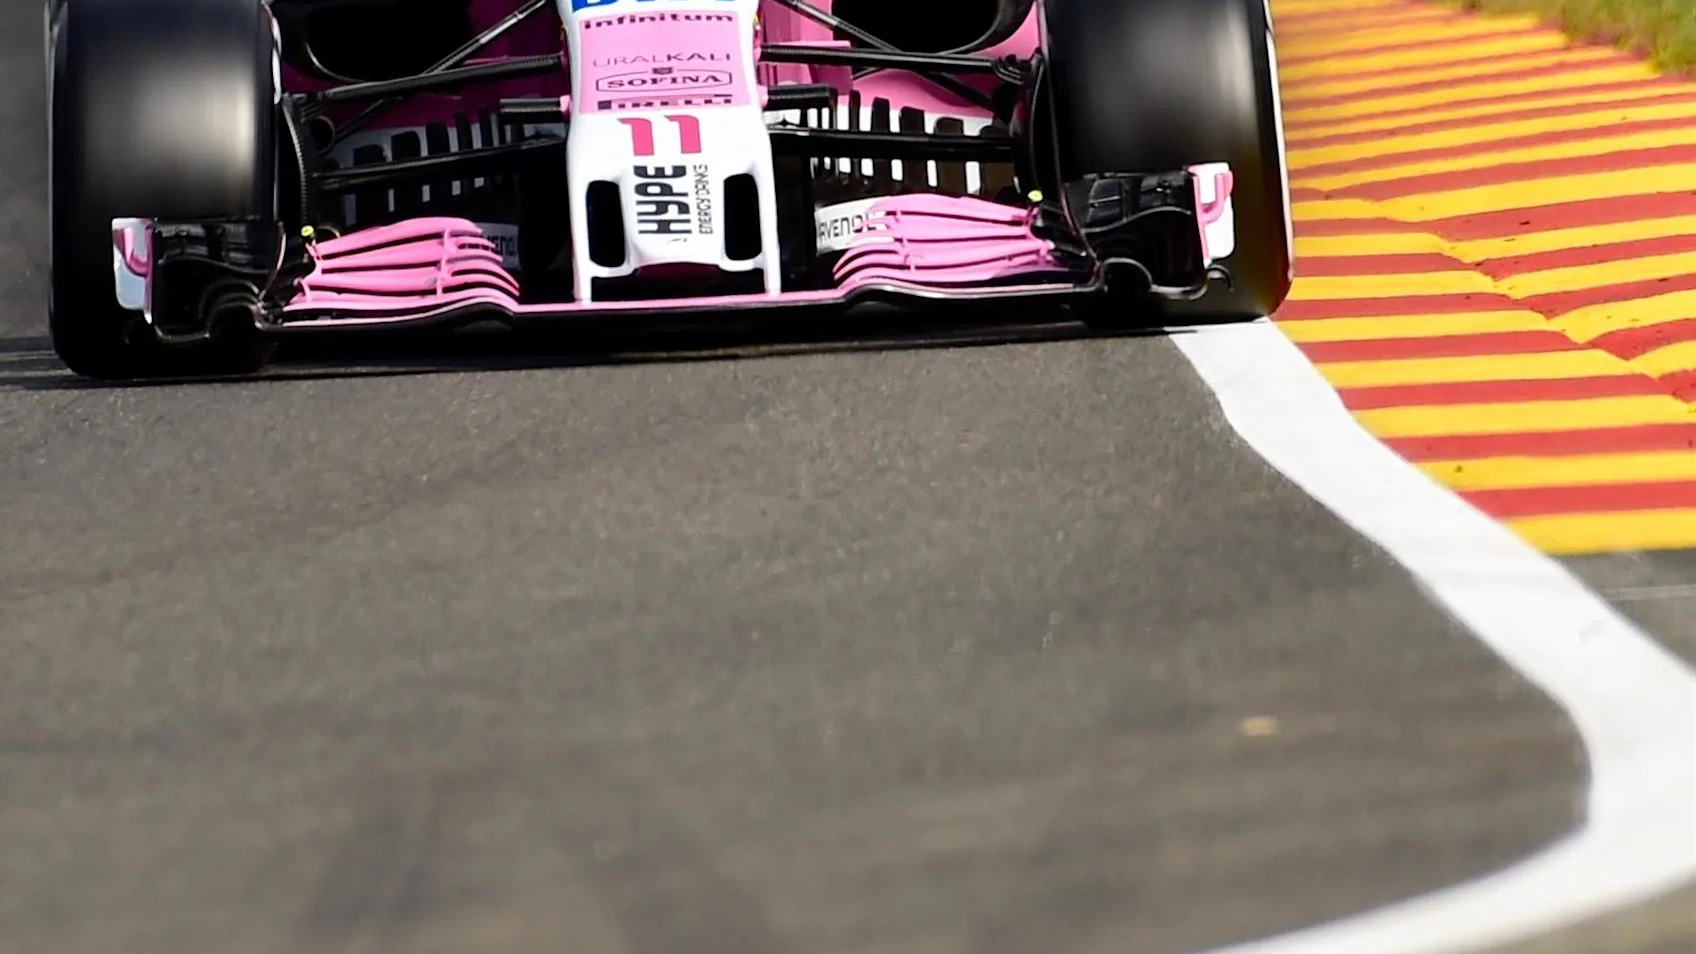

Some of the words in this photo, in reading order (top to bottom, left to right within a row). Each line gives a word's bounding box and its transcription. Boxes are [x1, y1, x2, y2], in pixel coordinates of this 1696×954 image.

[584, 13, 733, 30] infinitum
[593, 52, 731, 68] URALKALI
[607, 75, 722, 89] SOFINA
[597, 94, 733, 110] PIRELLI
[617, 114, 702, 157] 11
[633, 164, 692, 235] HYPE
